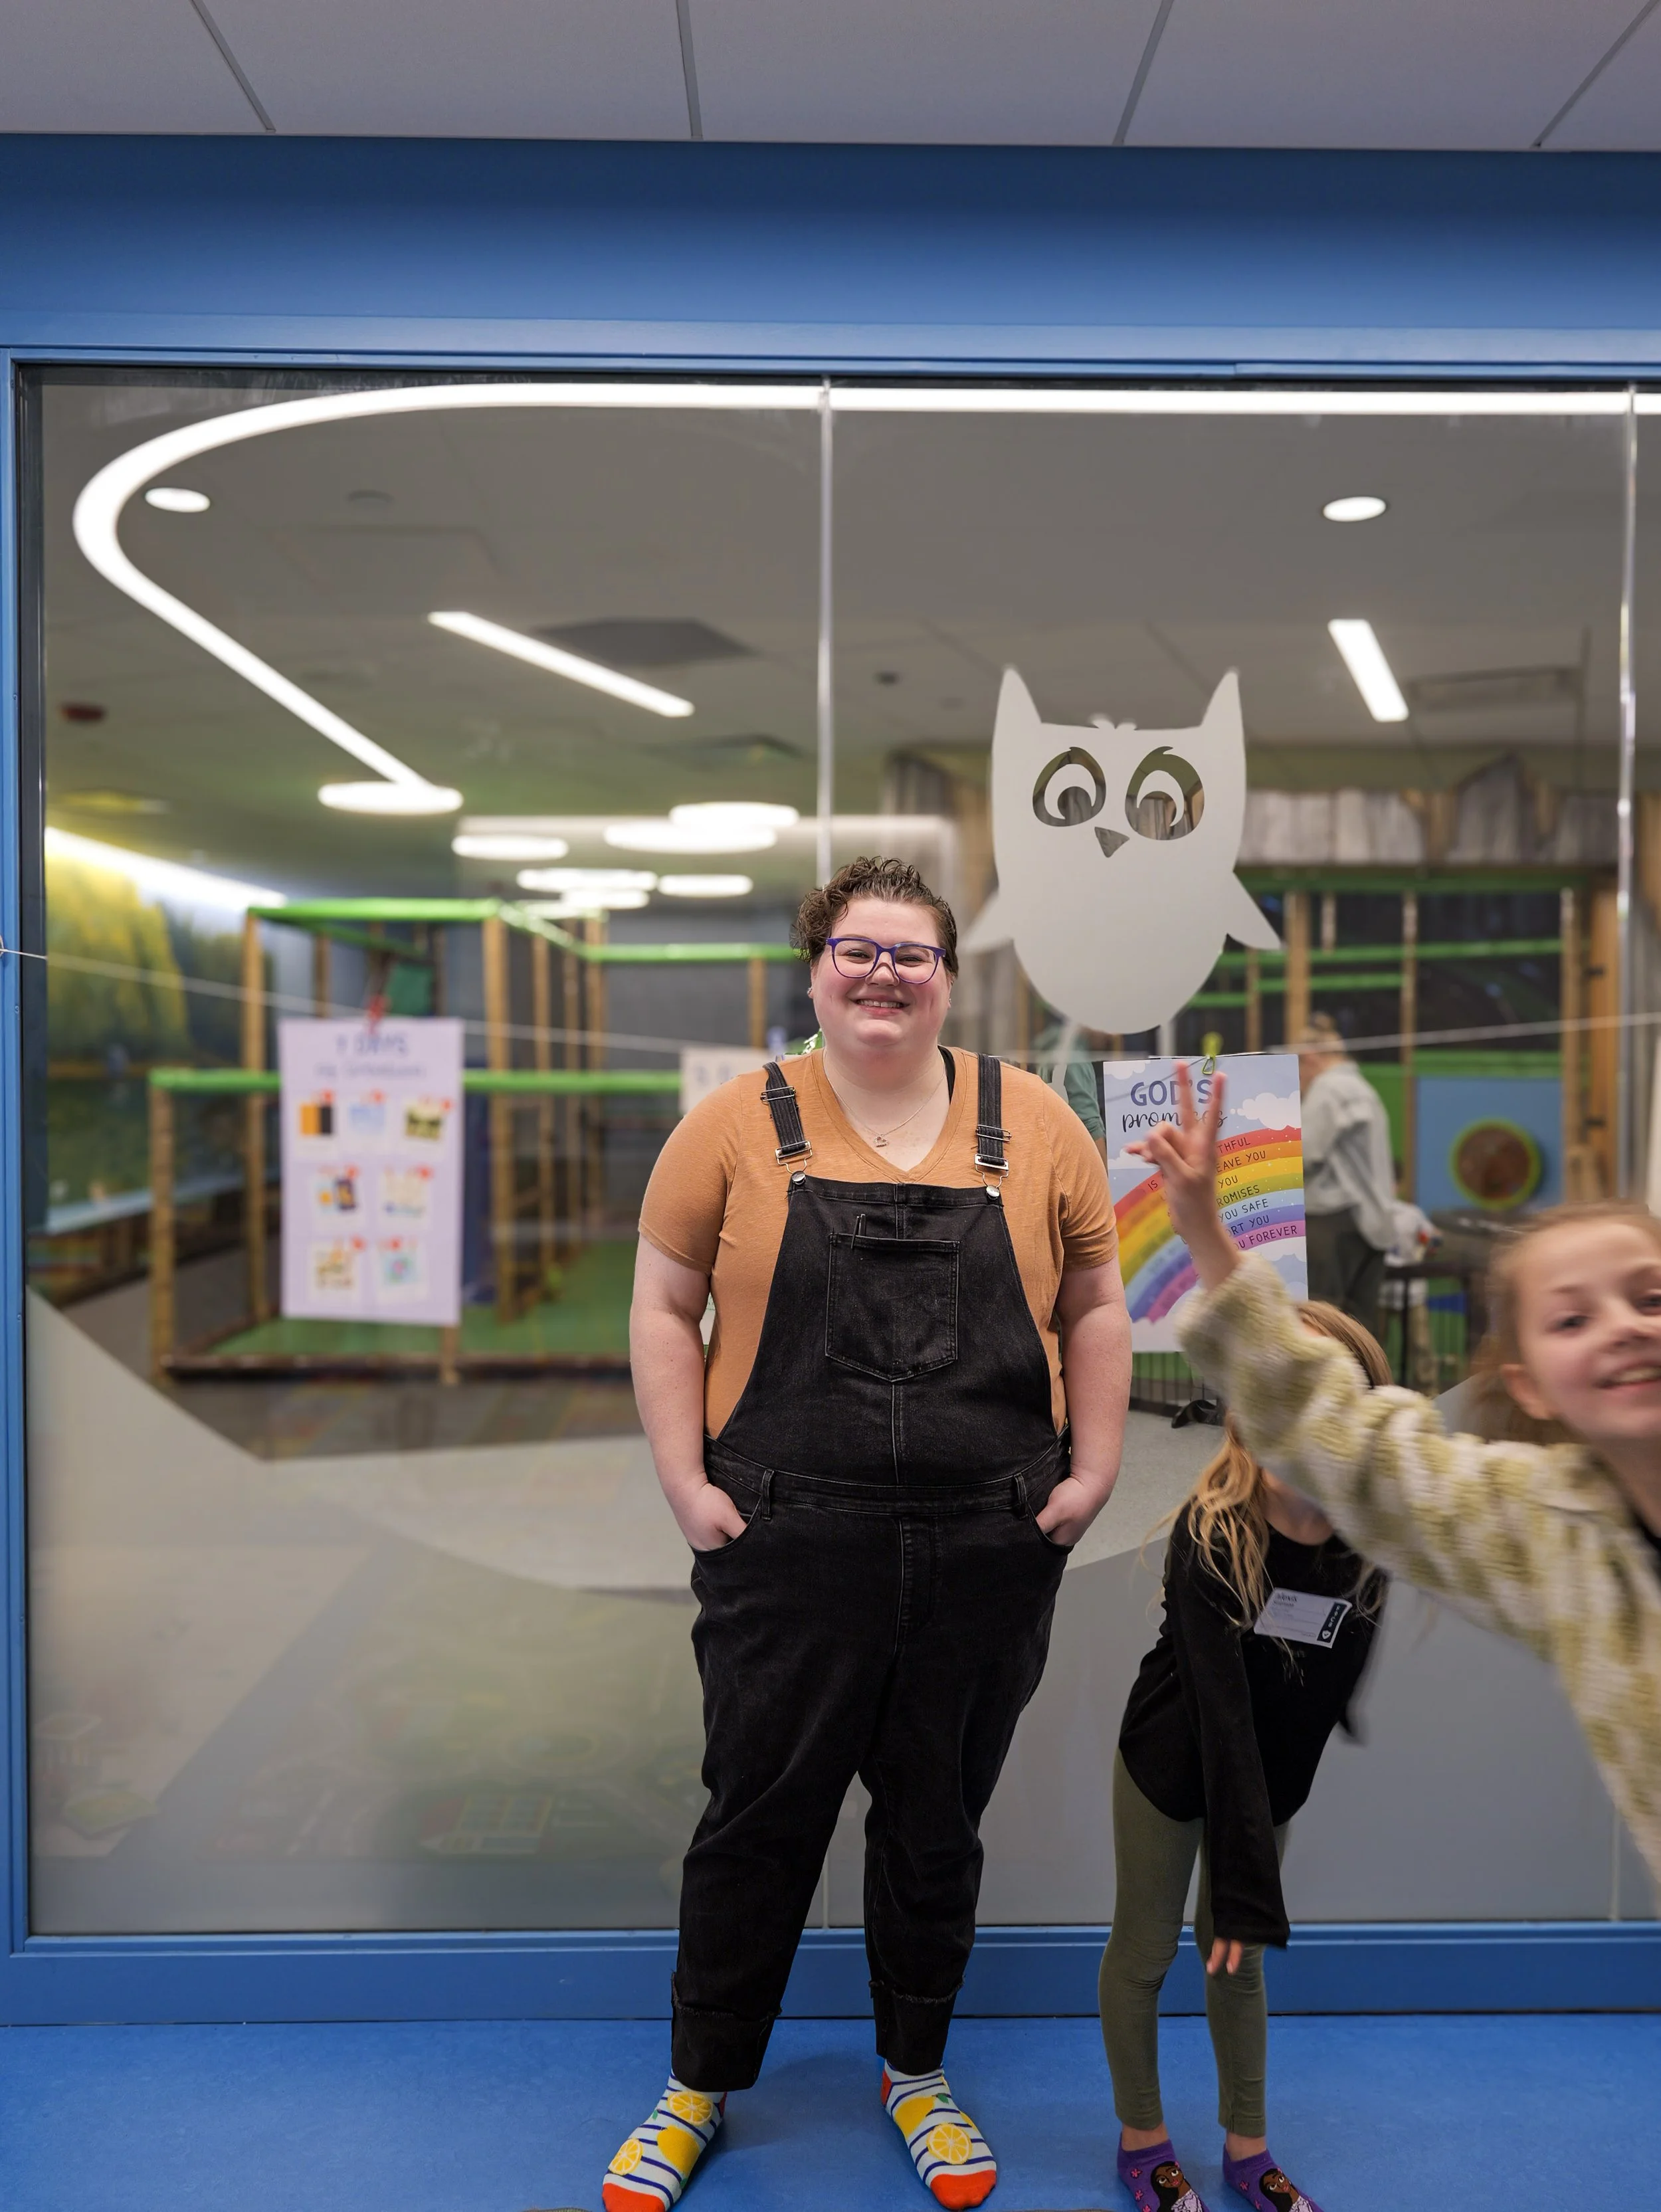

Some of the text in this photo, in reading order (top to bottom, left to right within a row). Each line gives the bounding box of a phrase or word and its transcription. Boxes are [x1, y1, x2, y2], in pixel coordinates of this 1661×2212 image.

[1122, 1111, 1228, 1132] promses
[1148, 1138, 1250, 1191] IS THFUL
[1217, 1151, 1266, 1173] EAVE YOU
[1218, 1175, 1238, 1189] YOU
[1216, 1185, 1260, 1207] ROMISES
[1218, 1199, 1269, 1223] YOU SAFE
[1249, 1215, 1270, 1227] YOU
[1249, 1225, 1298, 1245] FOREVER
